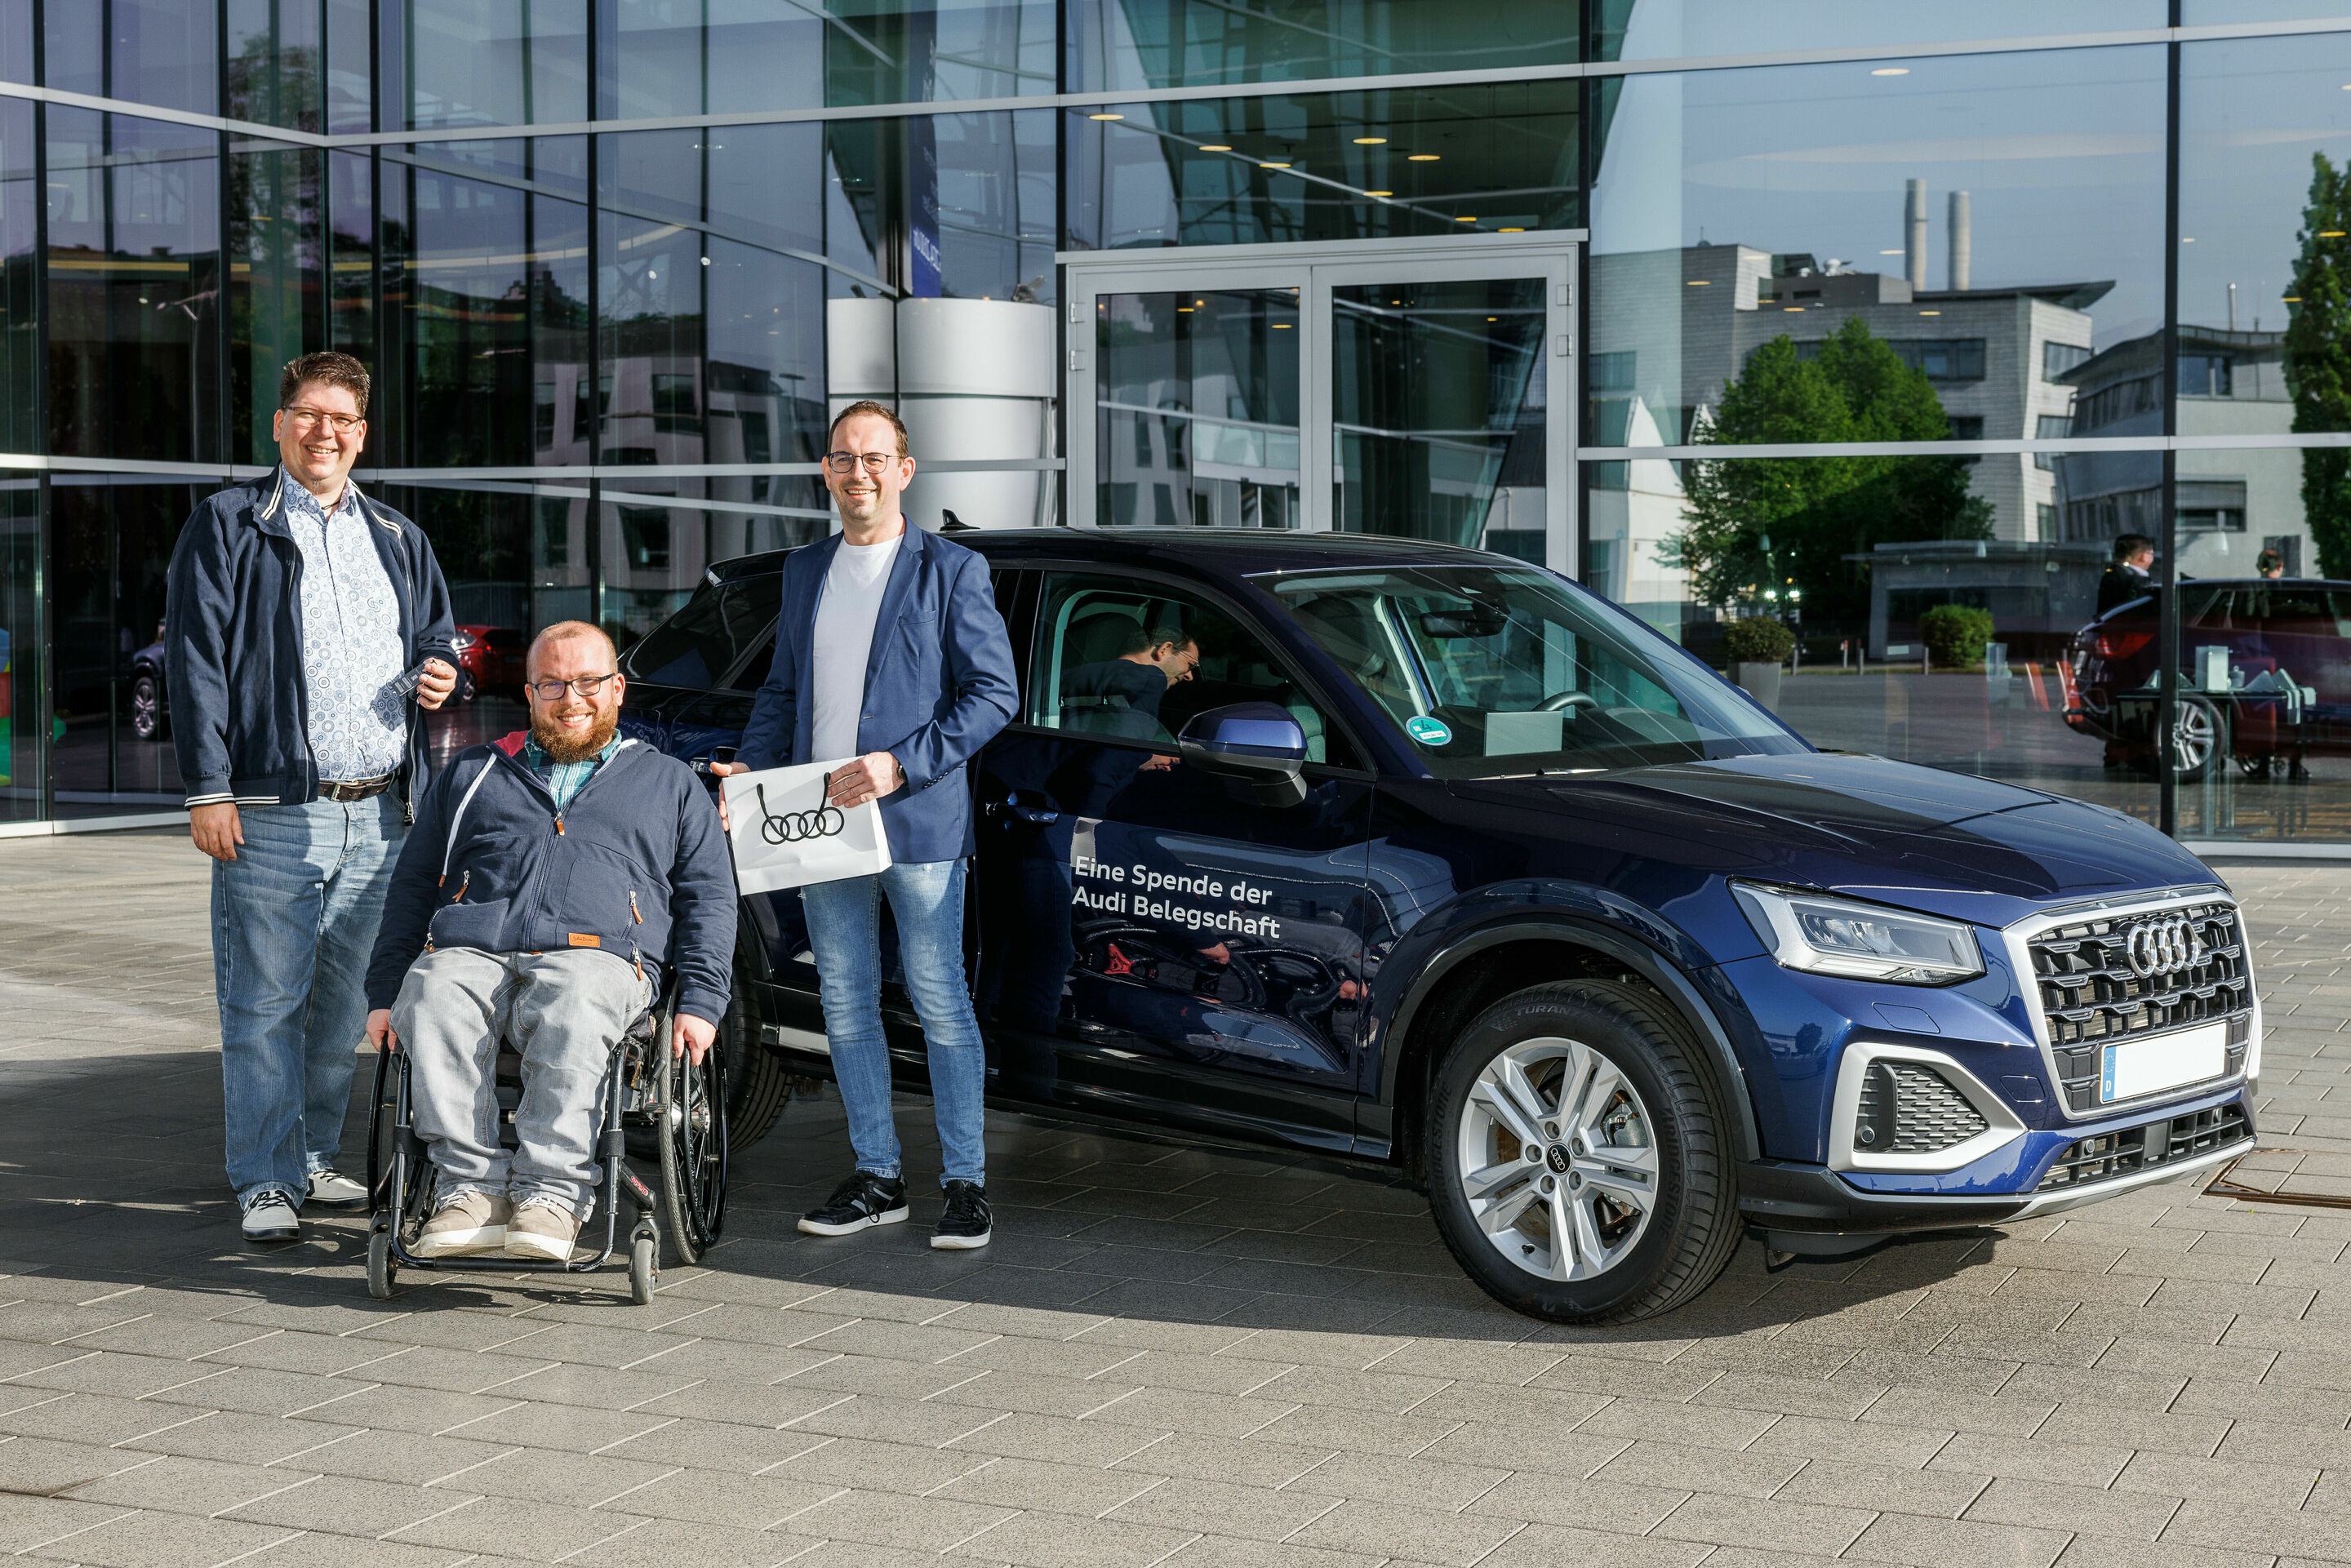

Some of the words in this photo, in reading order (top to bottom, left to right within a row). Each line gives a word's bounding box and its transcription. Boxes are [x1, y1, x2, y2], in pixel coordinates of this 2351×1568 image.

[1420, 719, 1432, 731] 4
[1074, 855, 1125, 882] Eine
[1131, 864, 1223, 897] Spende
[1230, 881, 1273, 905] der
[1072, 886, 1127, 913] Audi
[1133, 895, 1281, 939] Belegschaft
[2105, 1080, 2112, 1092] D
